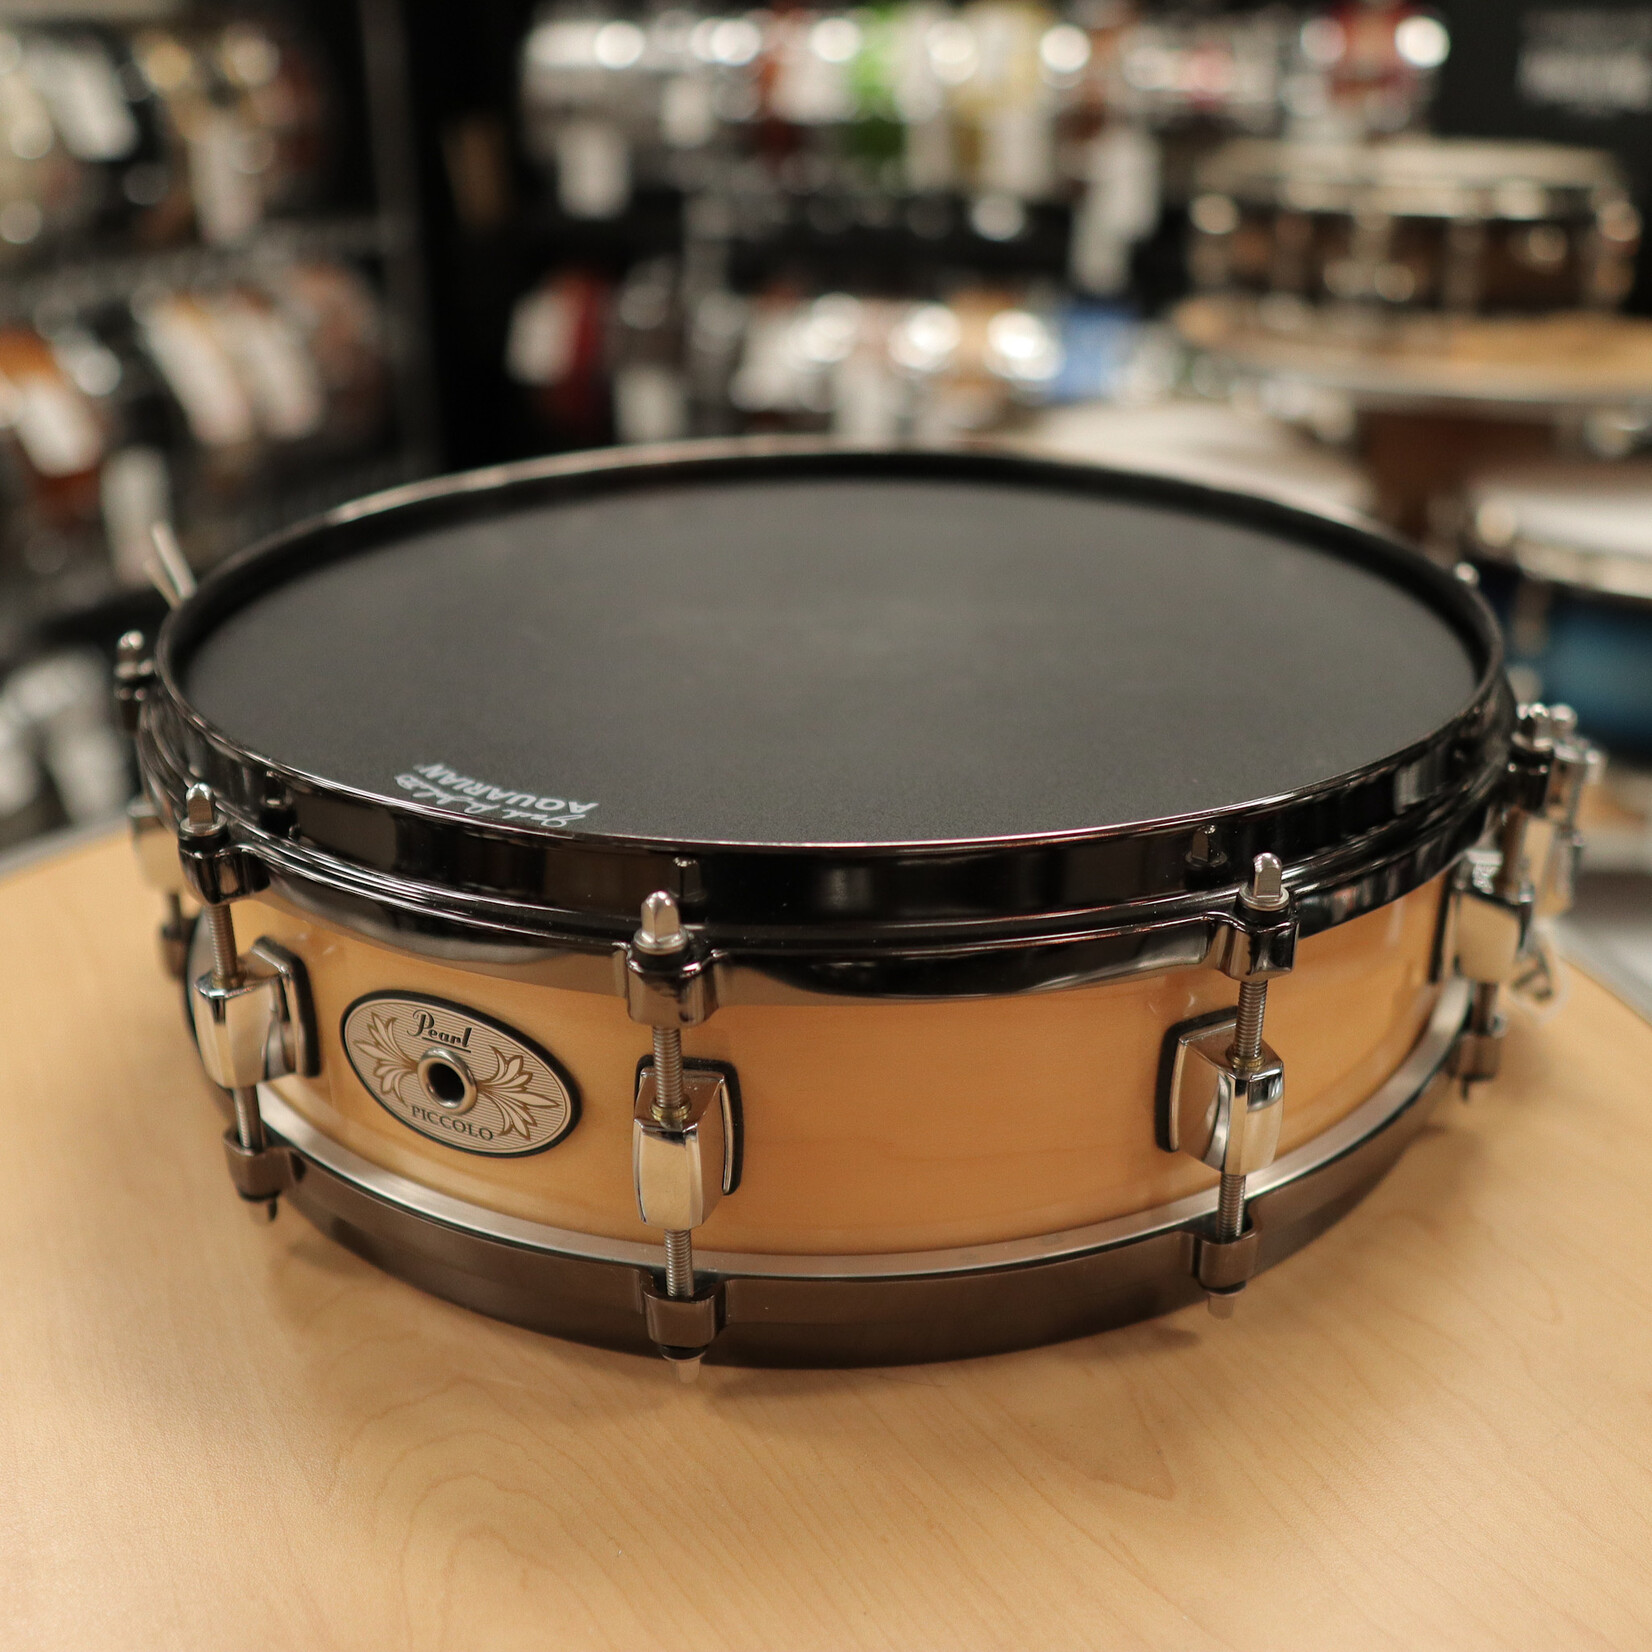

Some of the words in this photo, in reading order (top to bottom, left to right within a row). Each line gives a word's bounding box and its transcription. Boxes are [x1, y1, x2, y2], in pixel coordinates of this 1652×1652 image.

[416, 763, 599, 814] AQUARIAN
[407, 1009, 473, 1049] Pearl
[411, 1104, 494, 1142] PICCOLO
